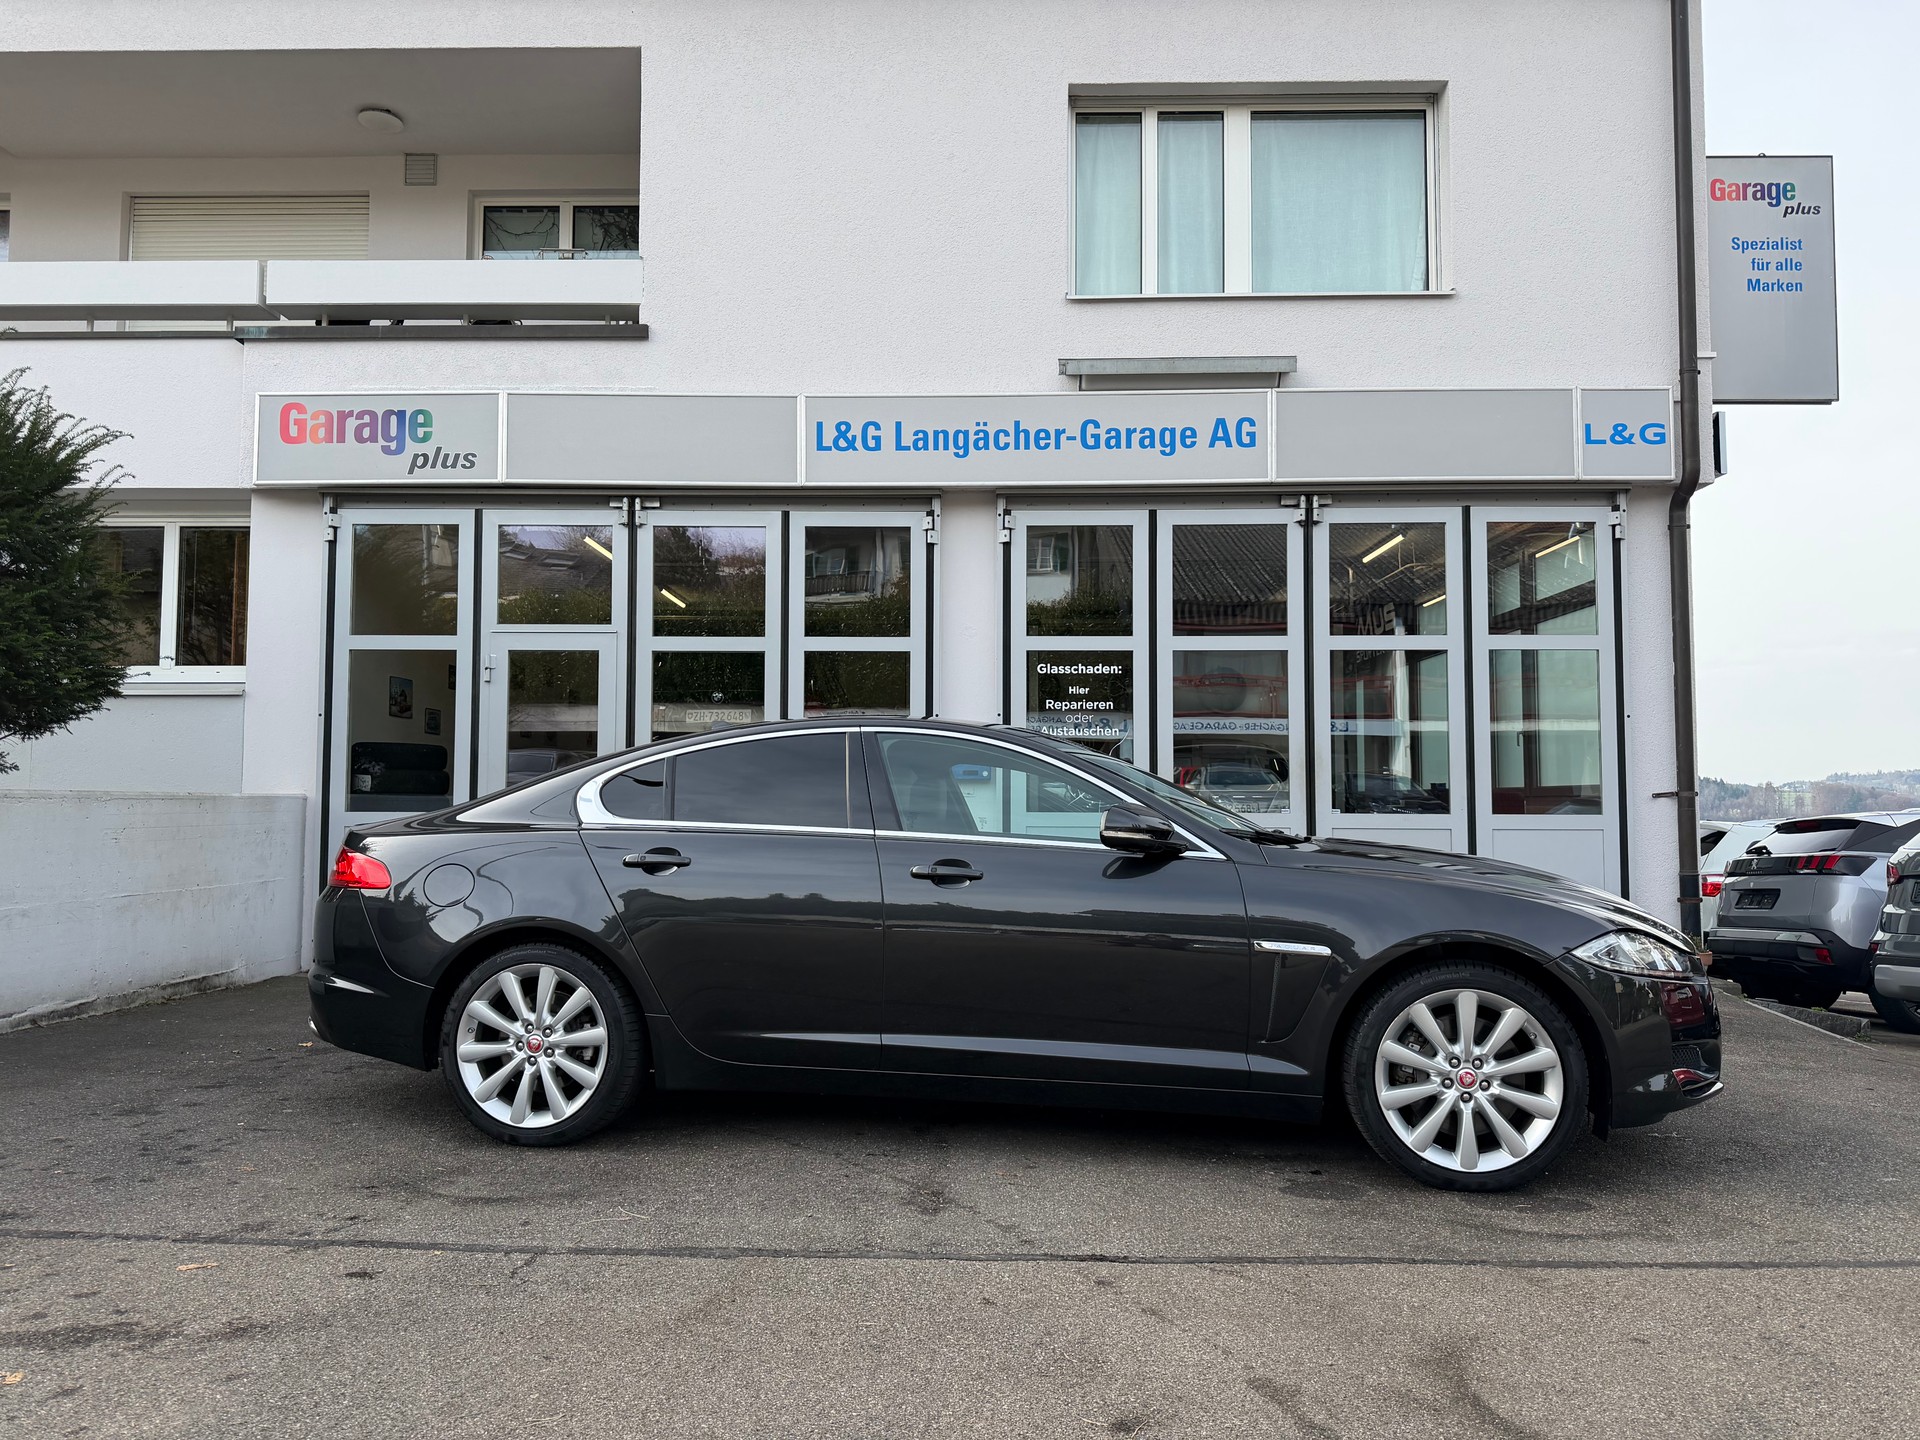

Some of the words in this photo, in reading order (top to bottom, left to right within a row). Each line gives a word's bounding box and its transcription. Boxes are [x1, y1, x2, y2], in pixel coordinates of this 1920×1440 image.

[1710, 178, 1796, 208] Garage
[1783, 201, 1822, 218] plus
[1731, 237, 1803, 253] Spezialist
[1750, 258, 1772, 272] für
[1775, 258, 1803, 272] alle
[1747, 278, 1803, 292] Marken
[279, 402, 433, 456] Garage
[1584, 422, 1667, 445] L&G
[816, 421, 882, 452] L&G
[895, 418, 1198, 459] Langächer-Garage
[1208, 416, 1257, 448] AG
[407, 445, 478, 475] plus
[1036, 663, 1122, 674] Glasschaden:
[1068, 686, 1090, 694] Hier
[1045, 699, 1114, 711] Reparieren
[1065, 713, 1094, 723] oder
[1041, 726, 1120, 736] Austauschen
